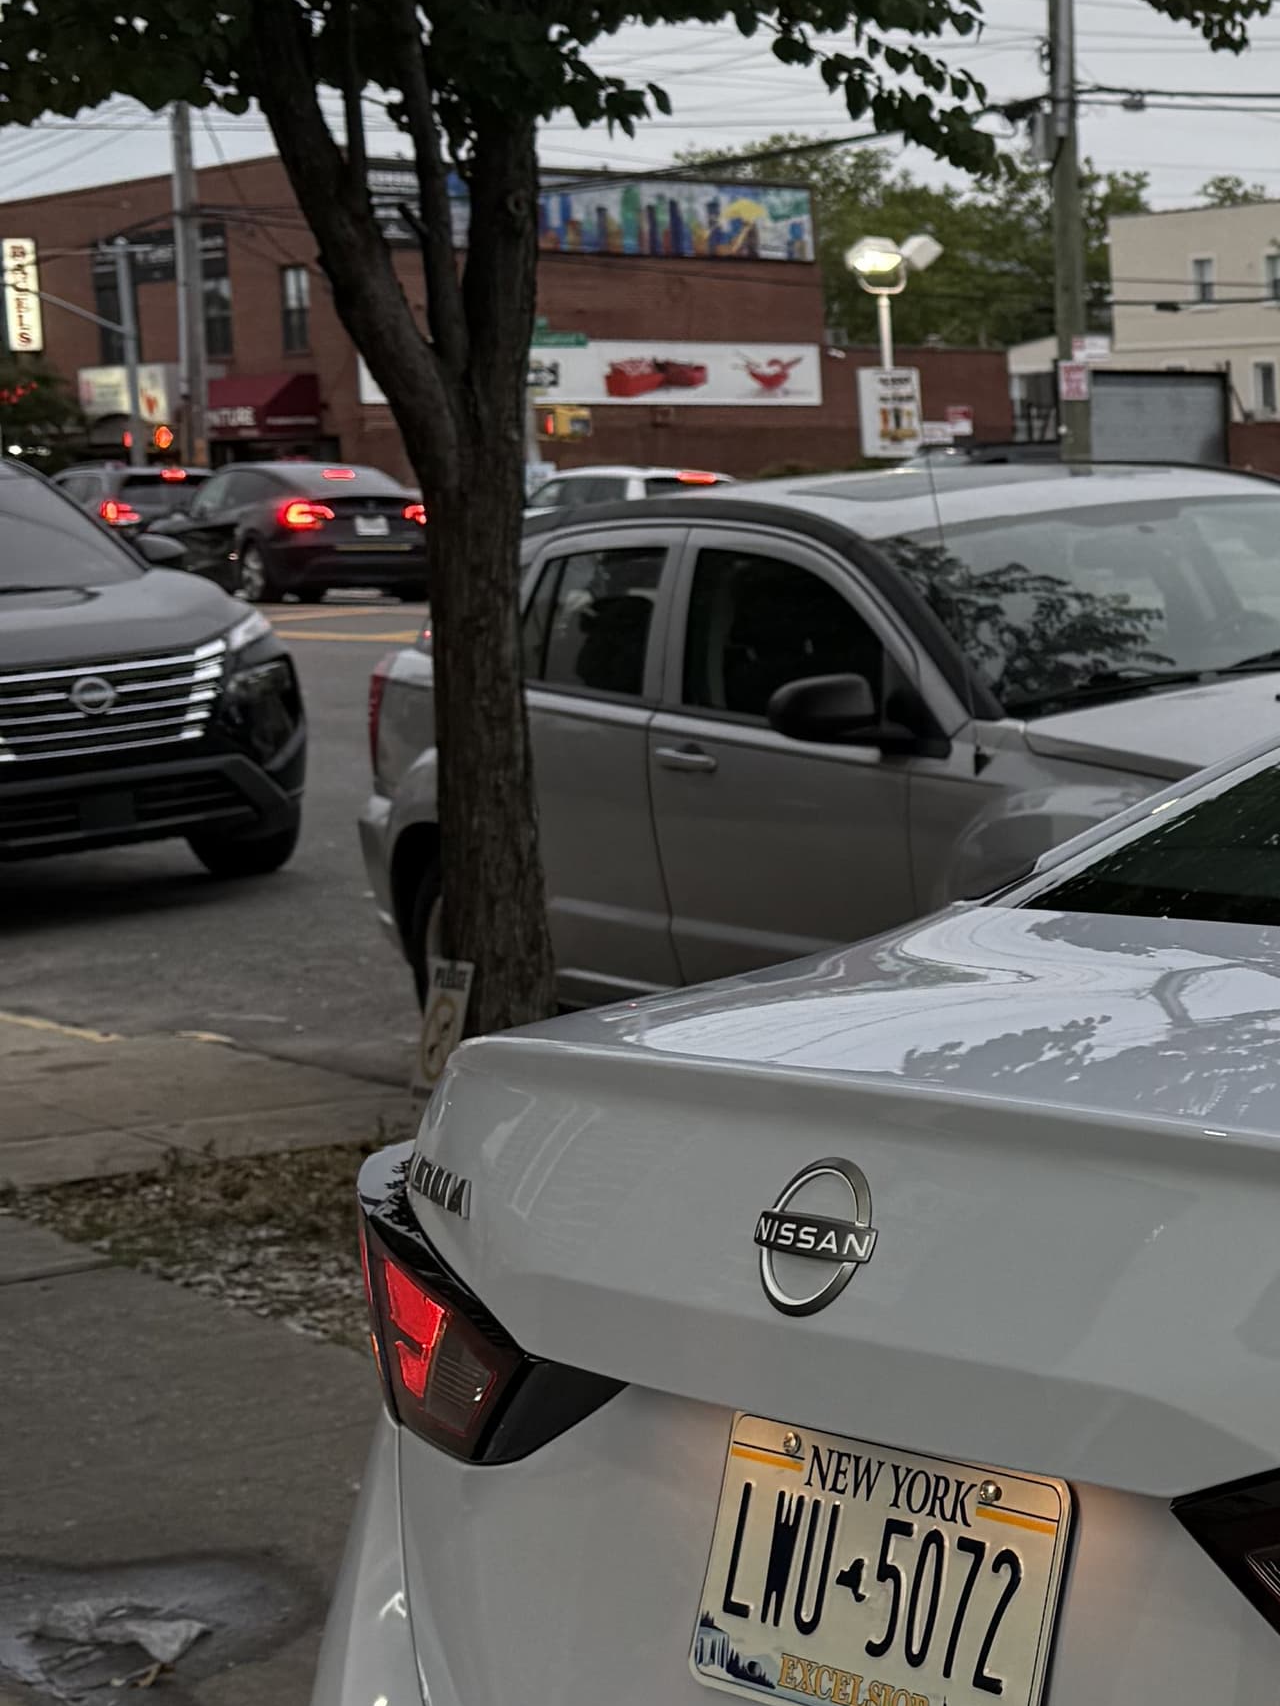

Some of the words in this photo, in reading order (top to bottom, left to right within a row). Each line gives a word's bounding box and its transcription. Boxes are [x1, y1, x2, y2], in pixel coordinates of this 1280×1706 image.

[755, 1216, 870, 1257] NISSAN
[803, 1444, 884, 1502] NEW
[889, 1463, 978, 1528] YORK
[722, 1481, 842, 1636] LWU
[864, 1517, 1024, 1696] 5072
